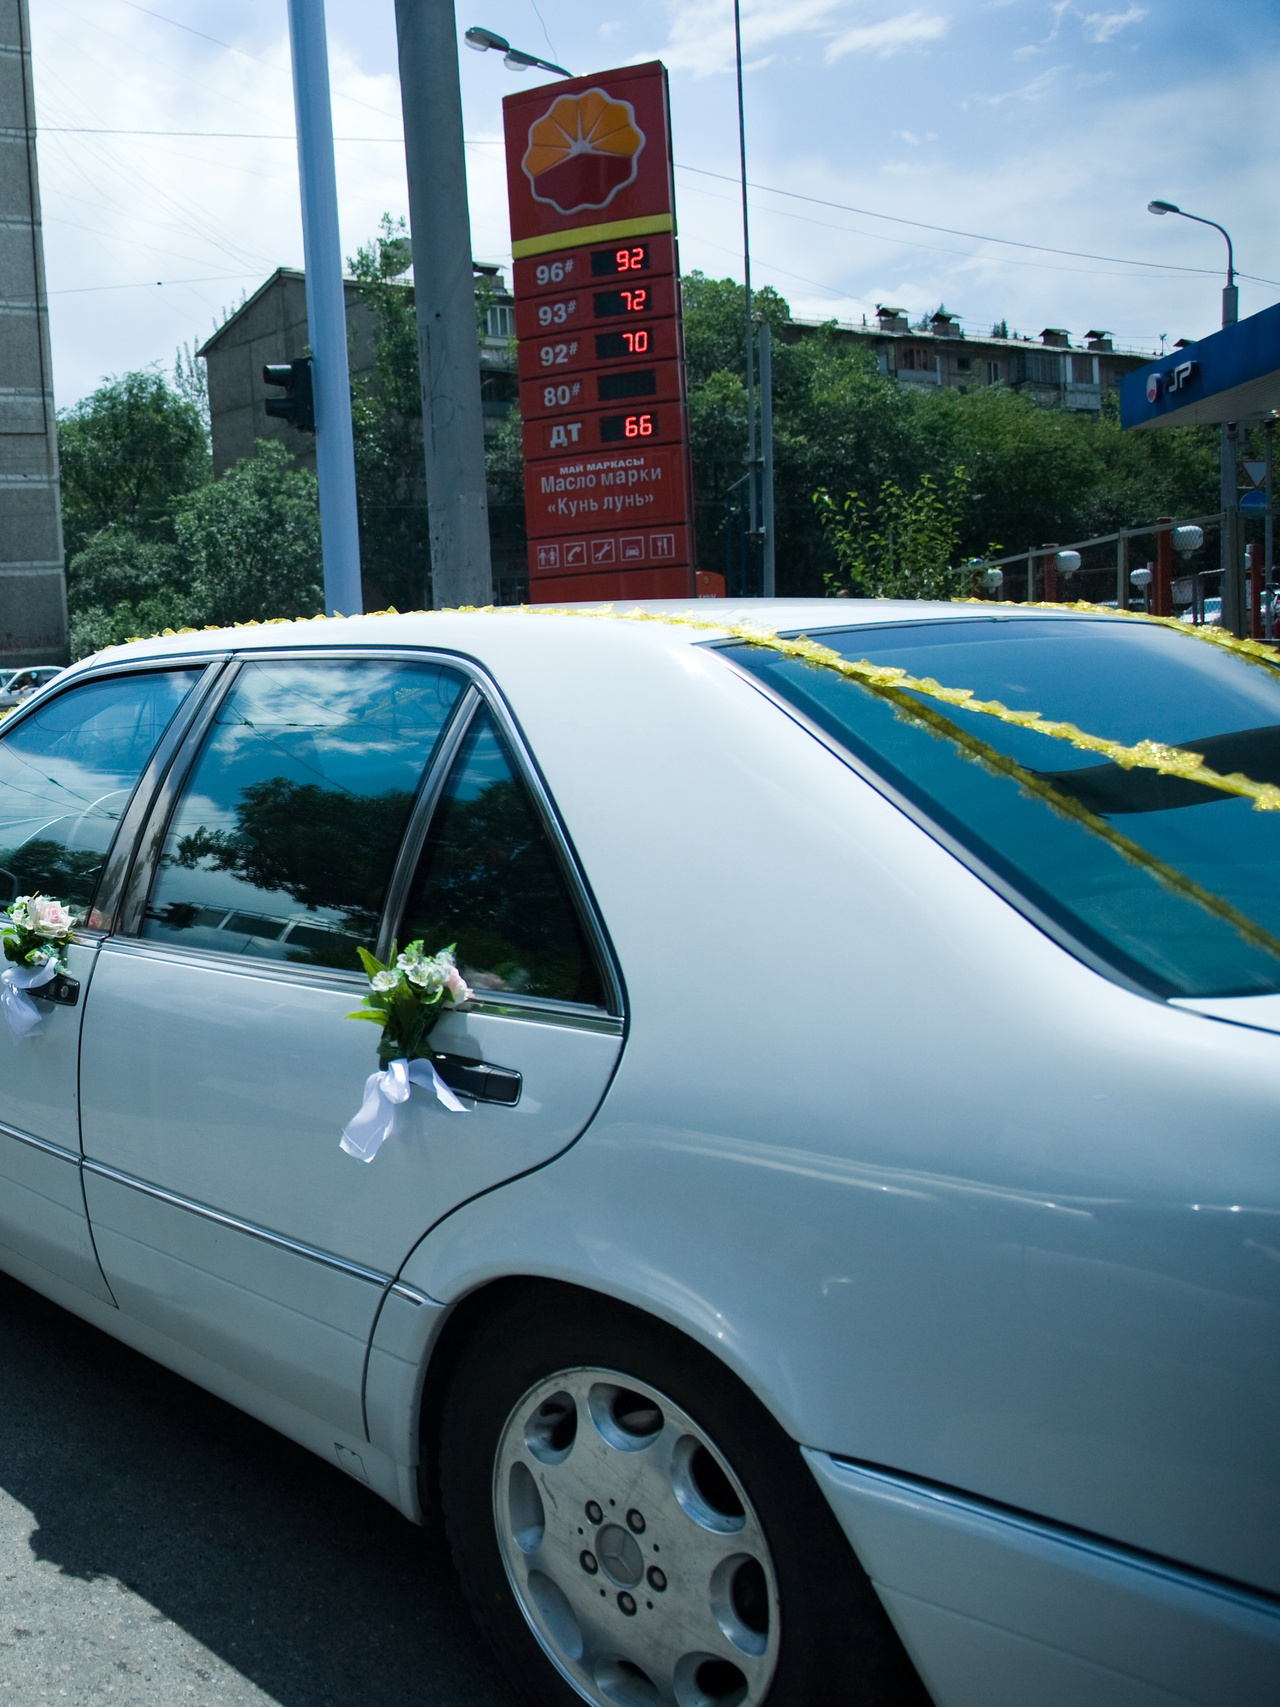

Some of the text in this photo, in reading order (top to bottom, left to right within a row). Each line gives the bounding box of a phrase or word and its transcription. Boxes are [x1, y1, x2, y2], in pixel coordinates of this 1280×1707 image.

[536, 247, 645, 285] 96# 92
[538, 289, 647, 326] 93# 72
[540, 330, 648, 367] 92# 70
[543, 382, 580, 407] 80#
[550, 414, 652, 448] ДТ 66
[541, 467, 662, 494] Масло марки
[559, 457, 645, 475] МАЙ МАРКАСЫ
[548, 493, 654, 517] «Кунь лунь»
